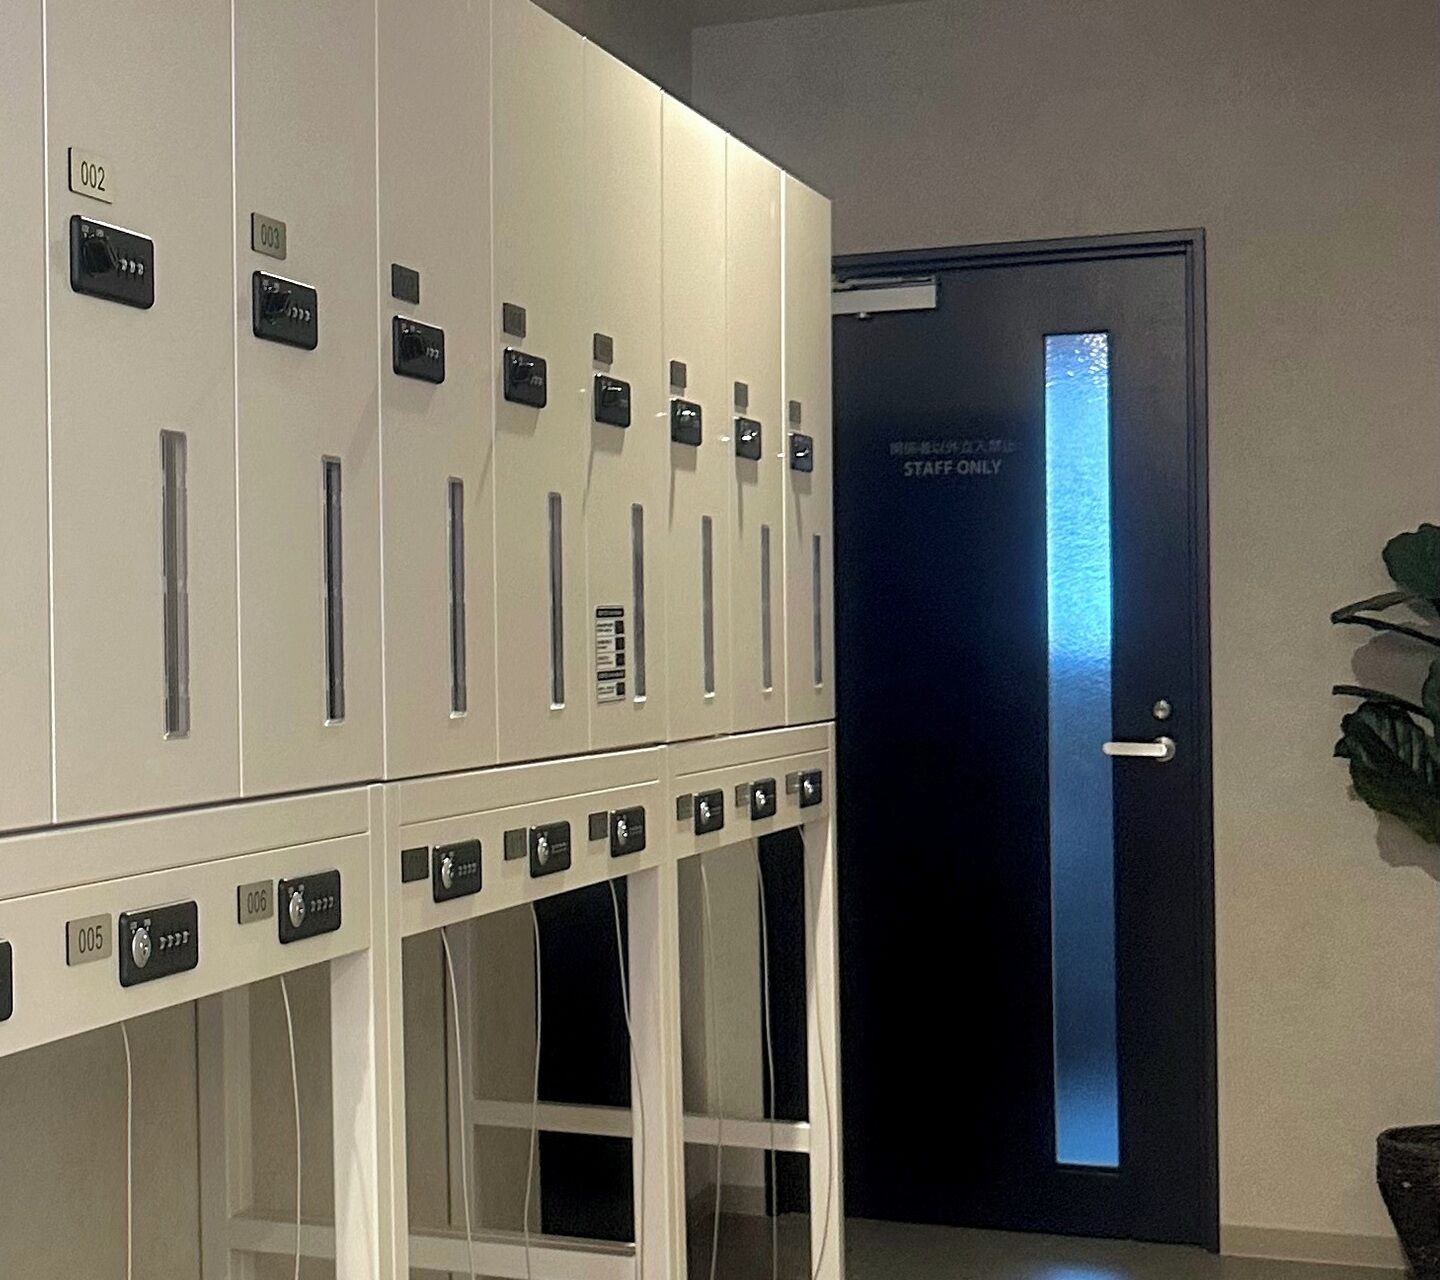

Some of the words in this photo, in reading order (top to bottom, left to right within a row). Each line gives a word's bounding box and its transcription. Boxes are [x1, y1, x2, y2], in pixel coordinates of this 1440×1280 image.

[80, 160, 106, 192] 002
[261, 223, 280, 251] 003
[903, 460, 953, 477] STAFF
[956, 459, 1003, 476] ONLY
[246, 889, 268, 914] 006
[77, 924, 105, 954] 005
